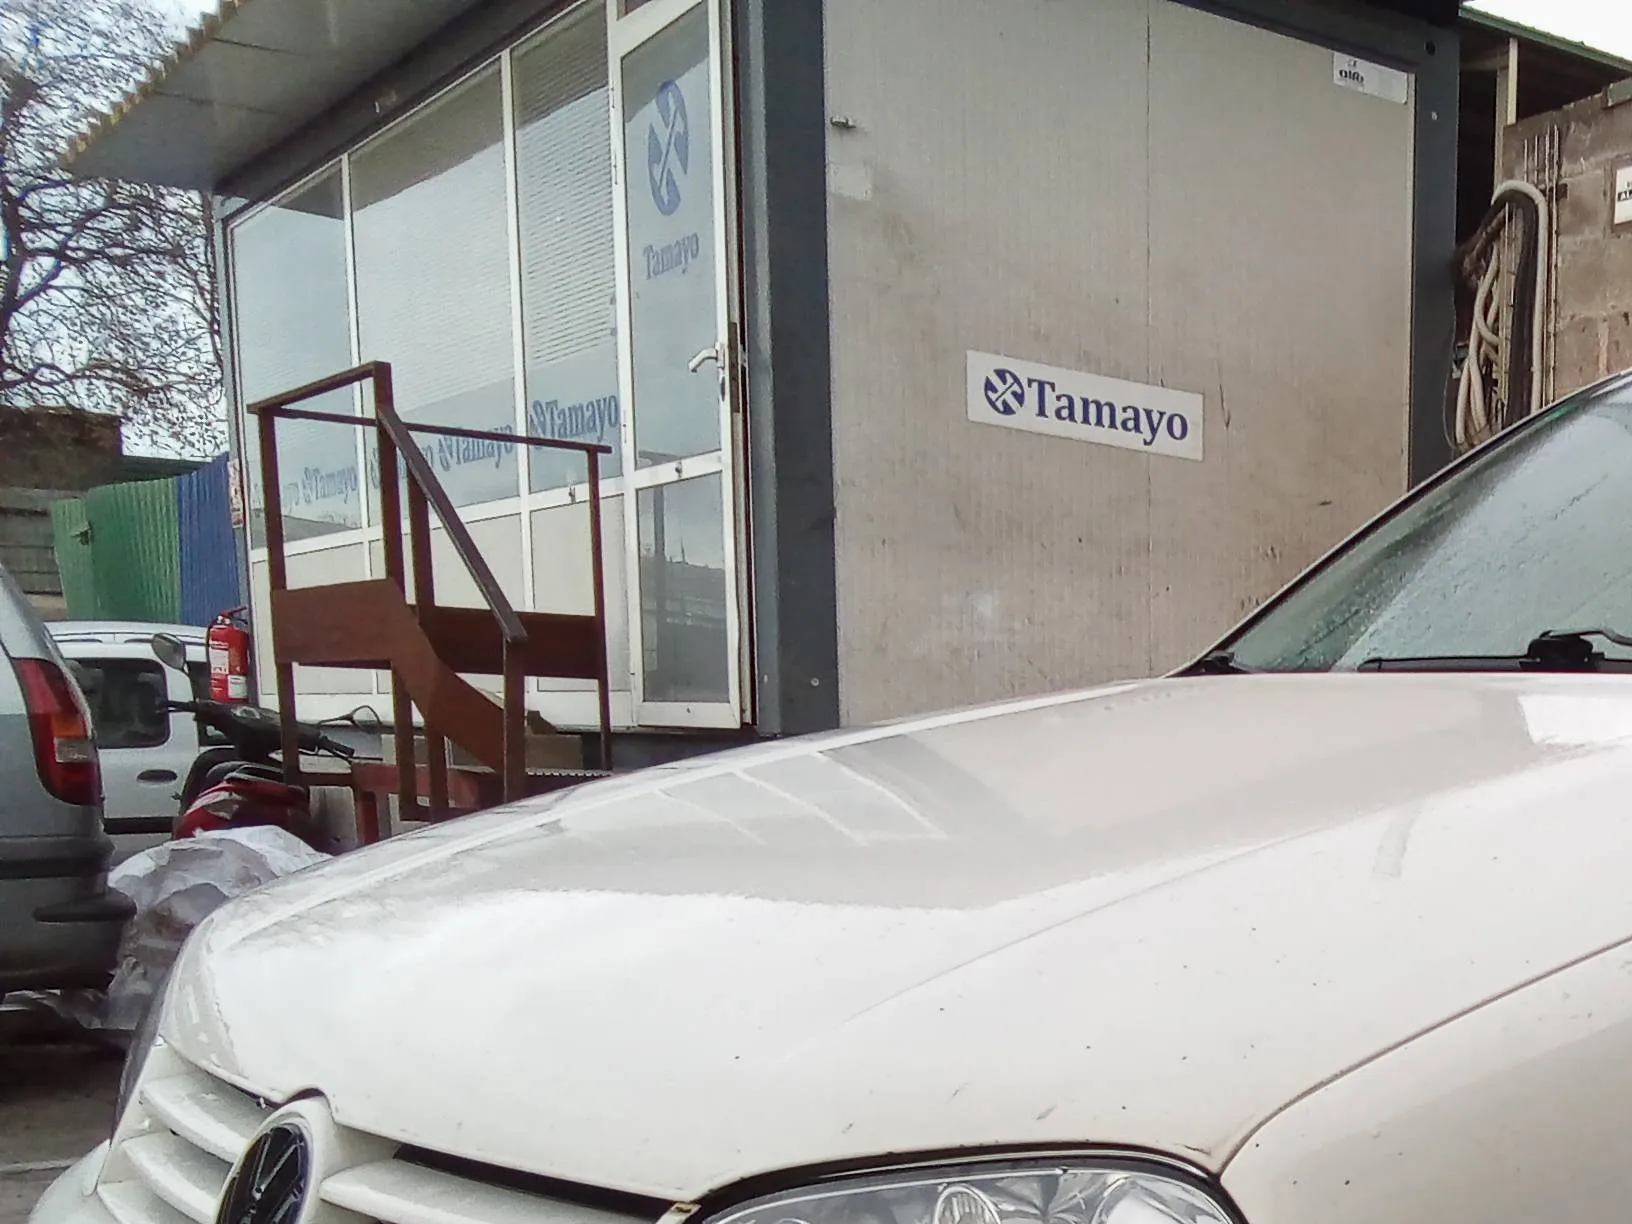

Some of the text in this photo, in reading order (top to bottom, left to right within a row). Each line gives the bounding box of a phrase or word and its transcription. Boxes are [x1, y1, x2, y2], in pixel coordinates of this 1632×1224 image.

[643, 232, 699, 280] Tamayo
[547, 395, 618, 442] Tamayo
[1027, 377, 1188, 447] Tamayo
